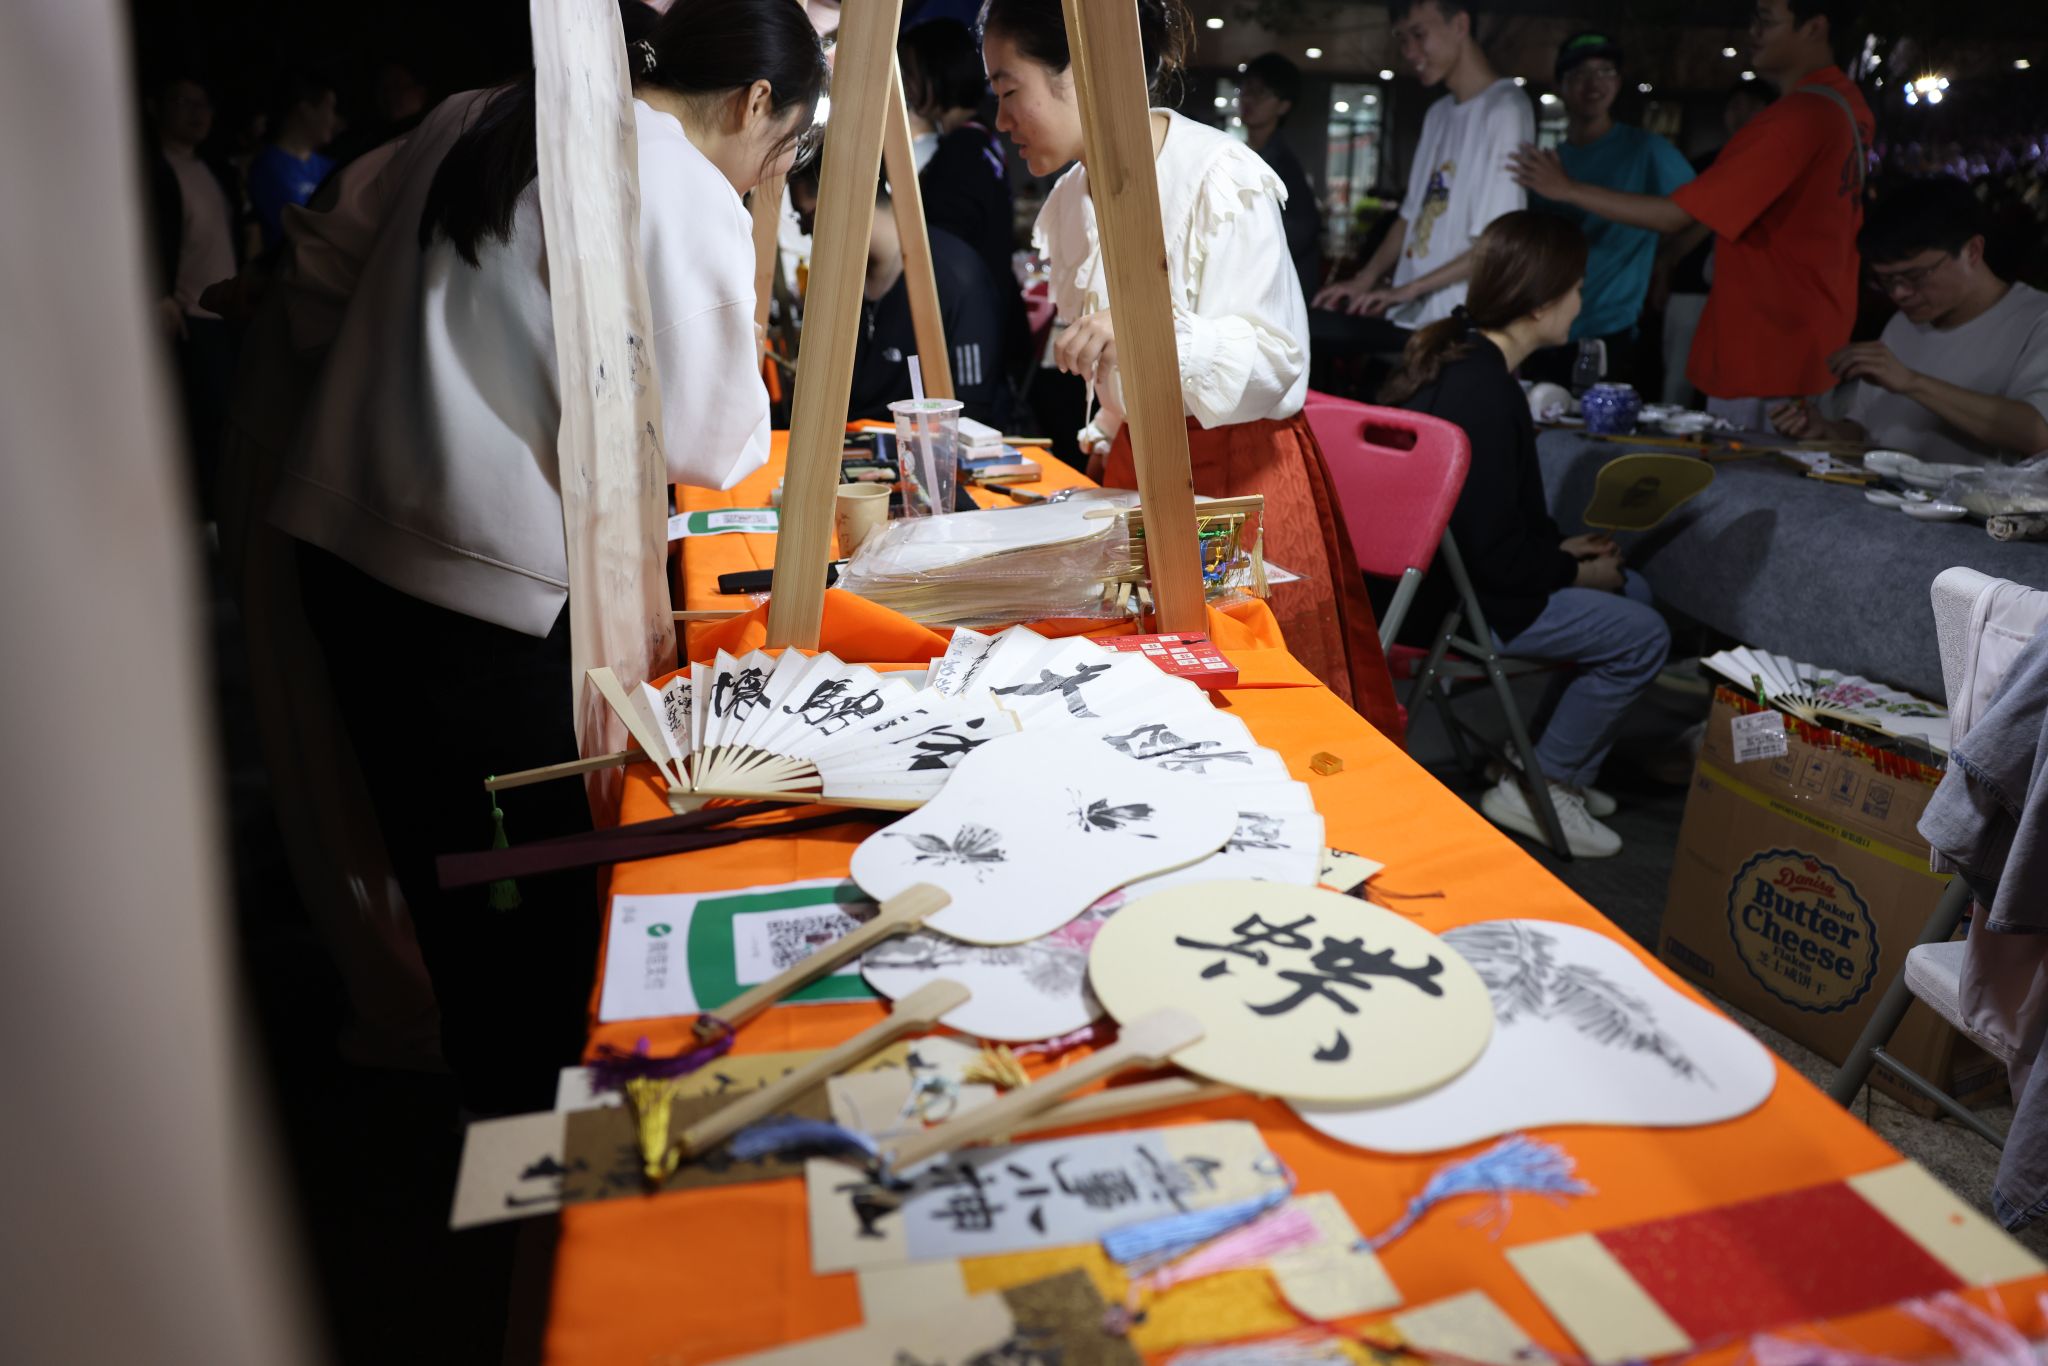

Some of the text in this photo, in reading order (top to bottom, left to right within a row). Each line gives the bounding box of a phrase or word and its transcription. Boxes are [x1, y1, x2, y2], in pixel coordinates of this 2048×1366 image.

[1773, 867, 1836, 895] Danisa
[1752, 878, 1859, 949] Butter
[1817, 897, 1855, 923] Baked
[1743, 904, 1854, 980] Cheese
[1774, 946, 1812, 973] Flakes
